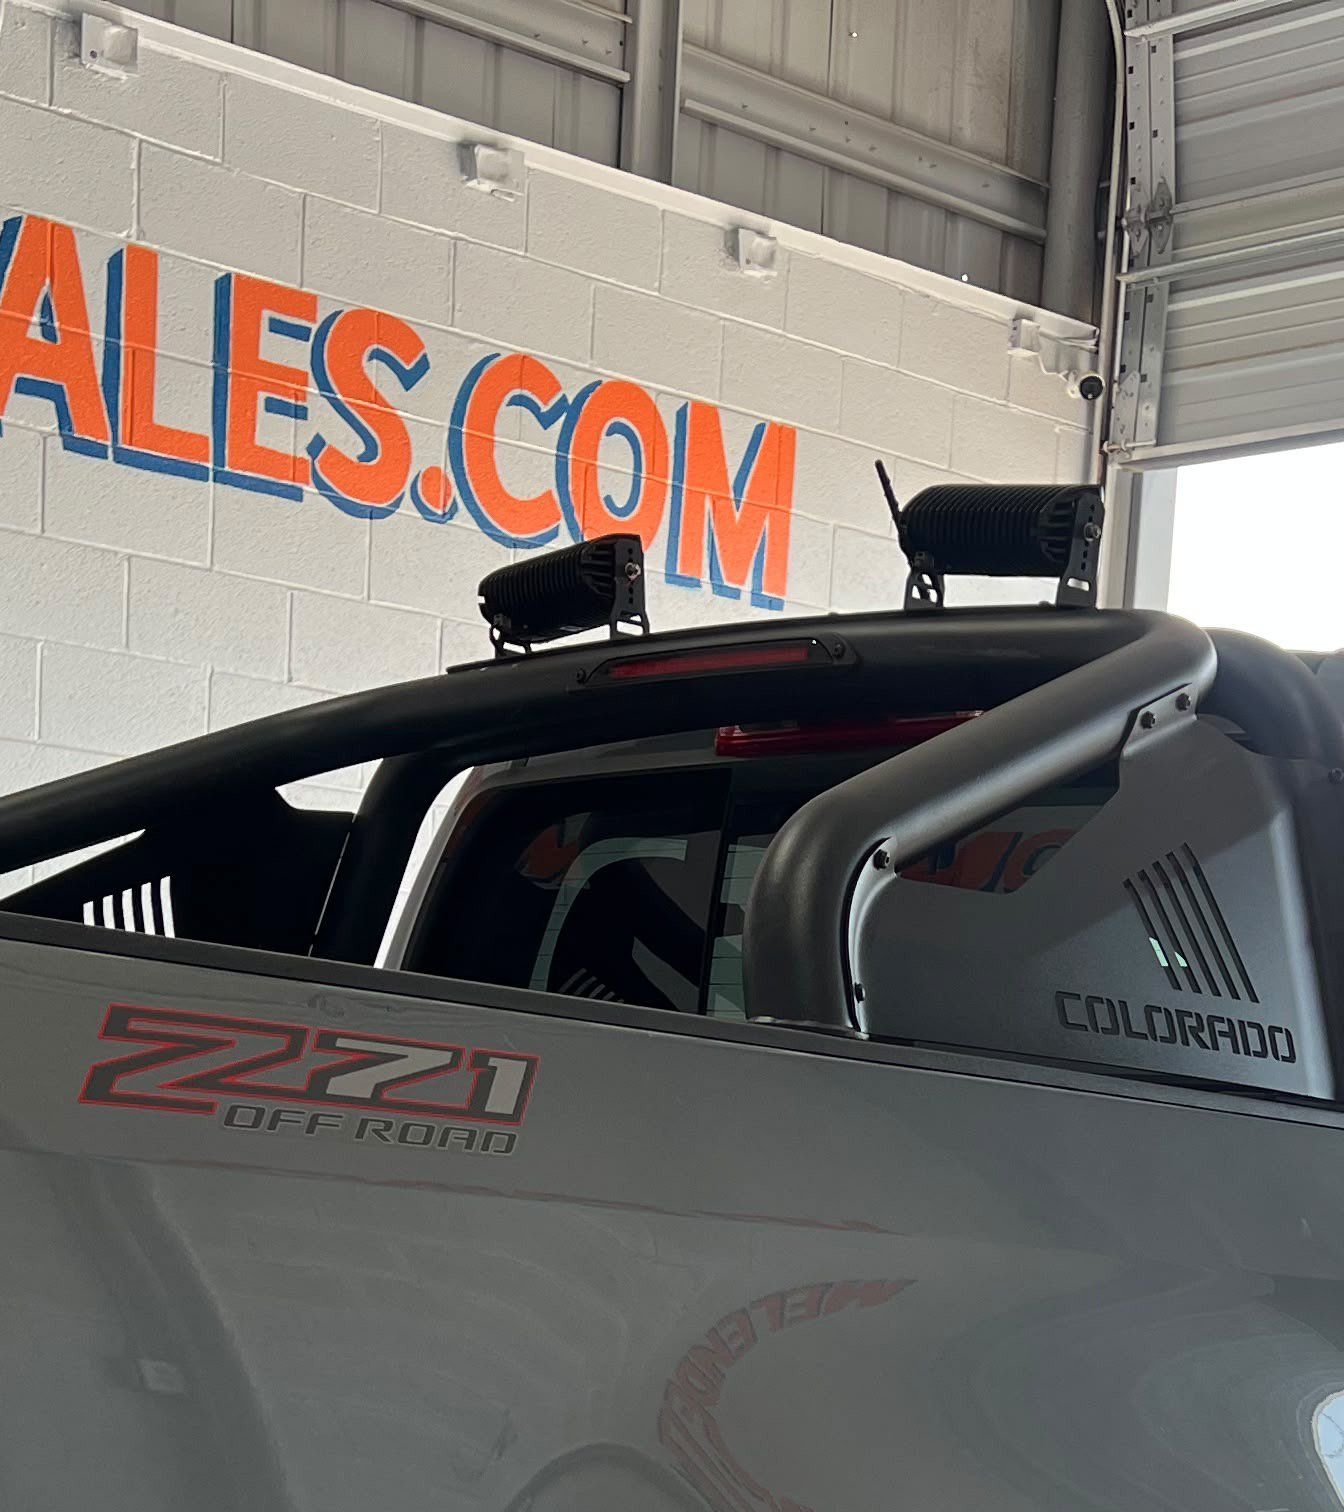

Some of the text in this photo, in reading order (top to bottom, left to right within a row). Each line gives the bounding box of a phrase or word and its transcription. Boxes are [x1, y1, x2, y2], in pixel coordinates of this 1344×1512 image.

[78, 1002, 541, 1126] Z71
[1056, 990, 1297, 1064] COLORADO
[223, 1104, 519, 1155] OFF ROAD
